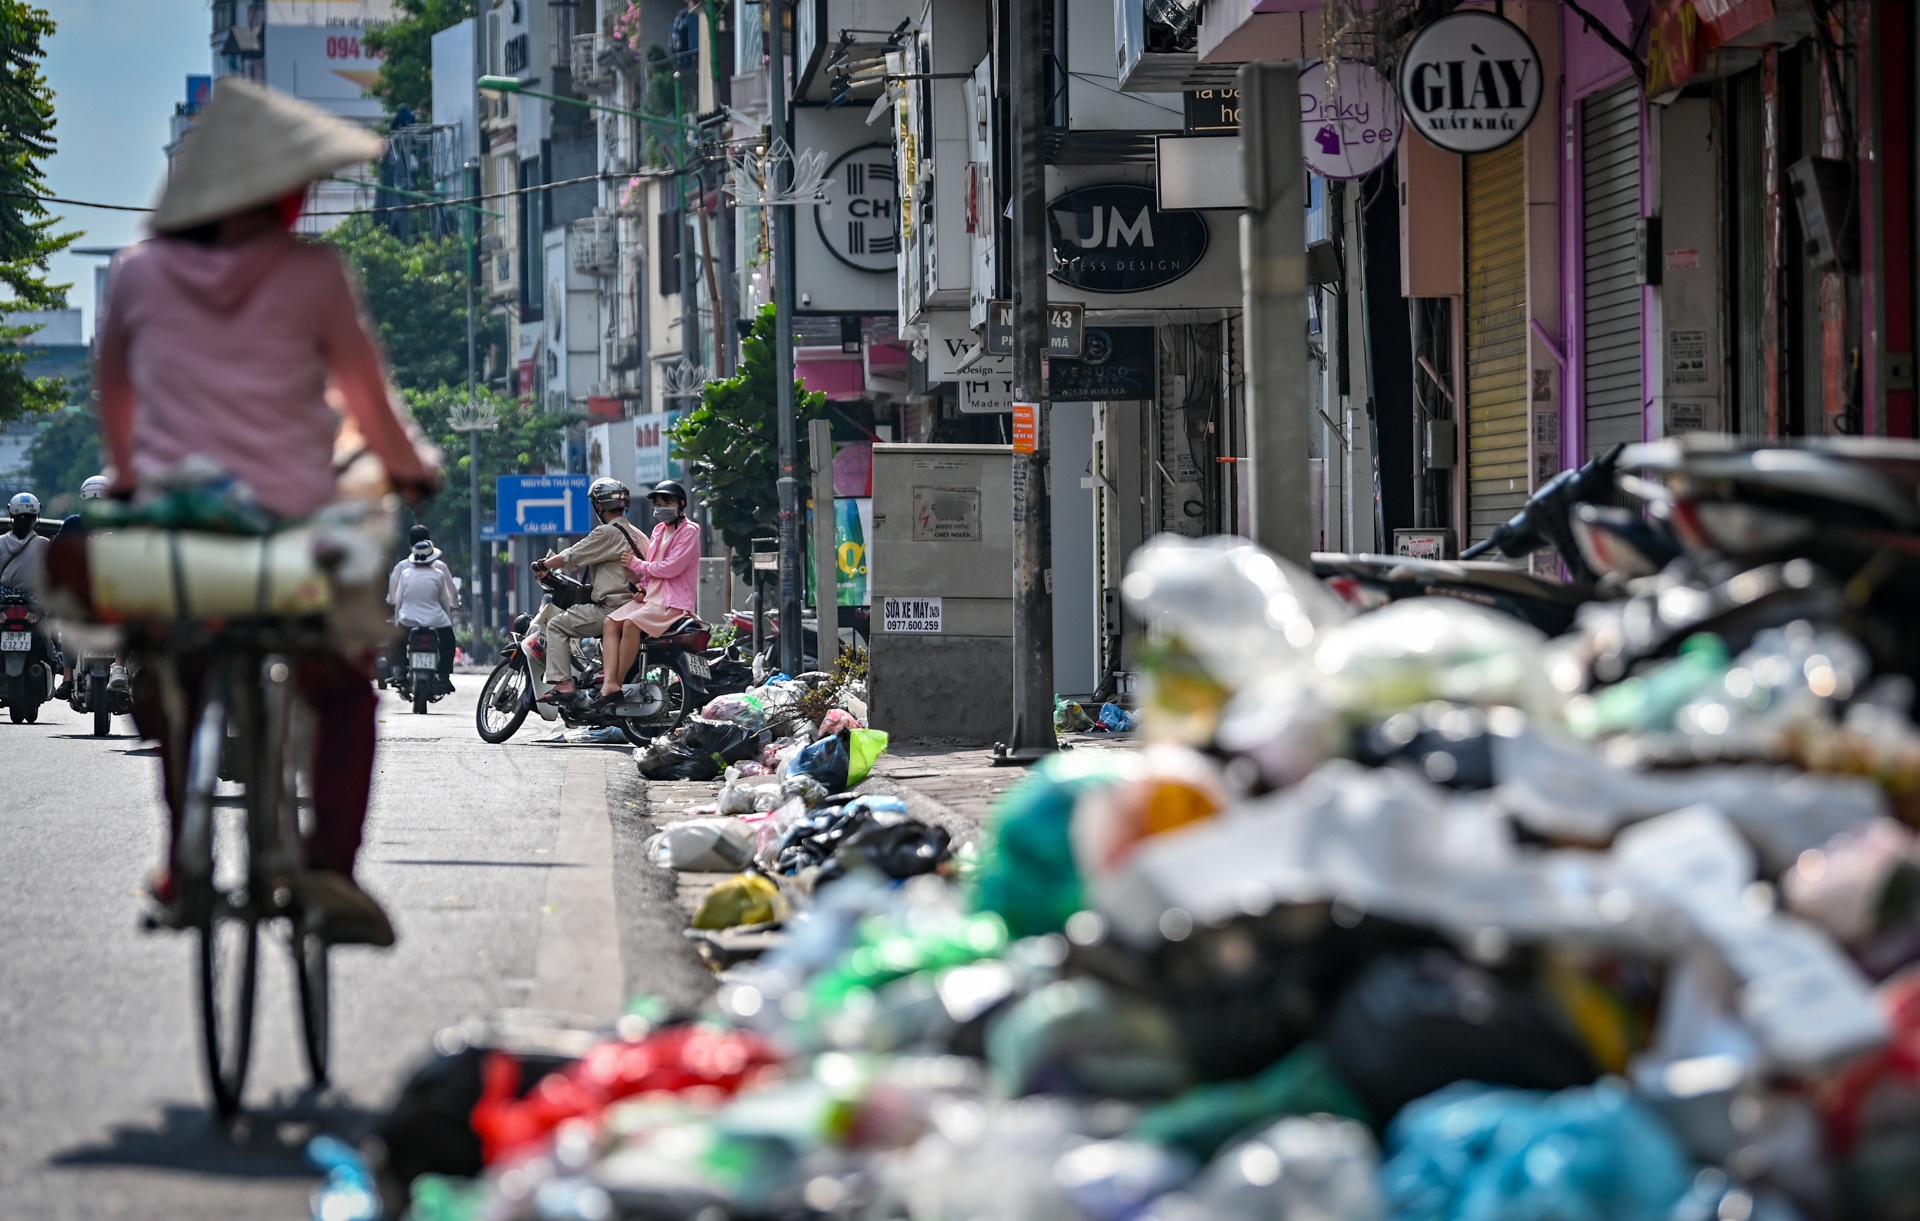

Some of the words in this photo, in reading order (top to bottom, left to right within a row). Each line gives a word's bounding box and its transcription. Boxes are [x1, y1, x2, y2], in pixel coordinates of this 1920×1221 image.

[326, 35, 360, 59] 094
[1410, 43, 1532, 113] GIÀY
[1299, 93, 1369, 124] Pinky
[1428, 110, 1467, 130] XUẤT
[1472, 112, 1517, 130] KHẨU
[1341, 123, 1393, 146] Lee
[1080, 205, 1155, 249] JM
[1116, 260, 1181, 271] DESIGN
[1047, 310, 1072, 329] 43
[1051, 335, 1069, 348] MÃ
[971, 400, 1000, 408] Made
[520, 476, 551, 488] NGUYỄN
[570, 478, 586, 488] HỌC
[885, 598, 900, 619] SỬA
[901, 601, 911, 619] XE
[913, 598, 929, 619] MÁY
[887, 620, 939, 631] 0977.600.259
[2, 641, 29, 650] 632.72
